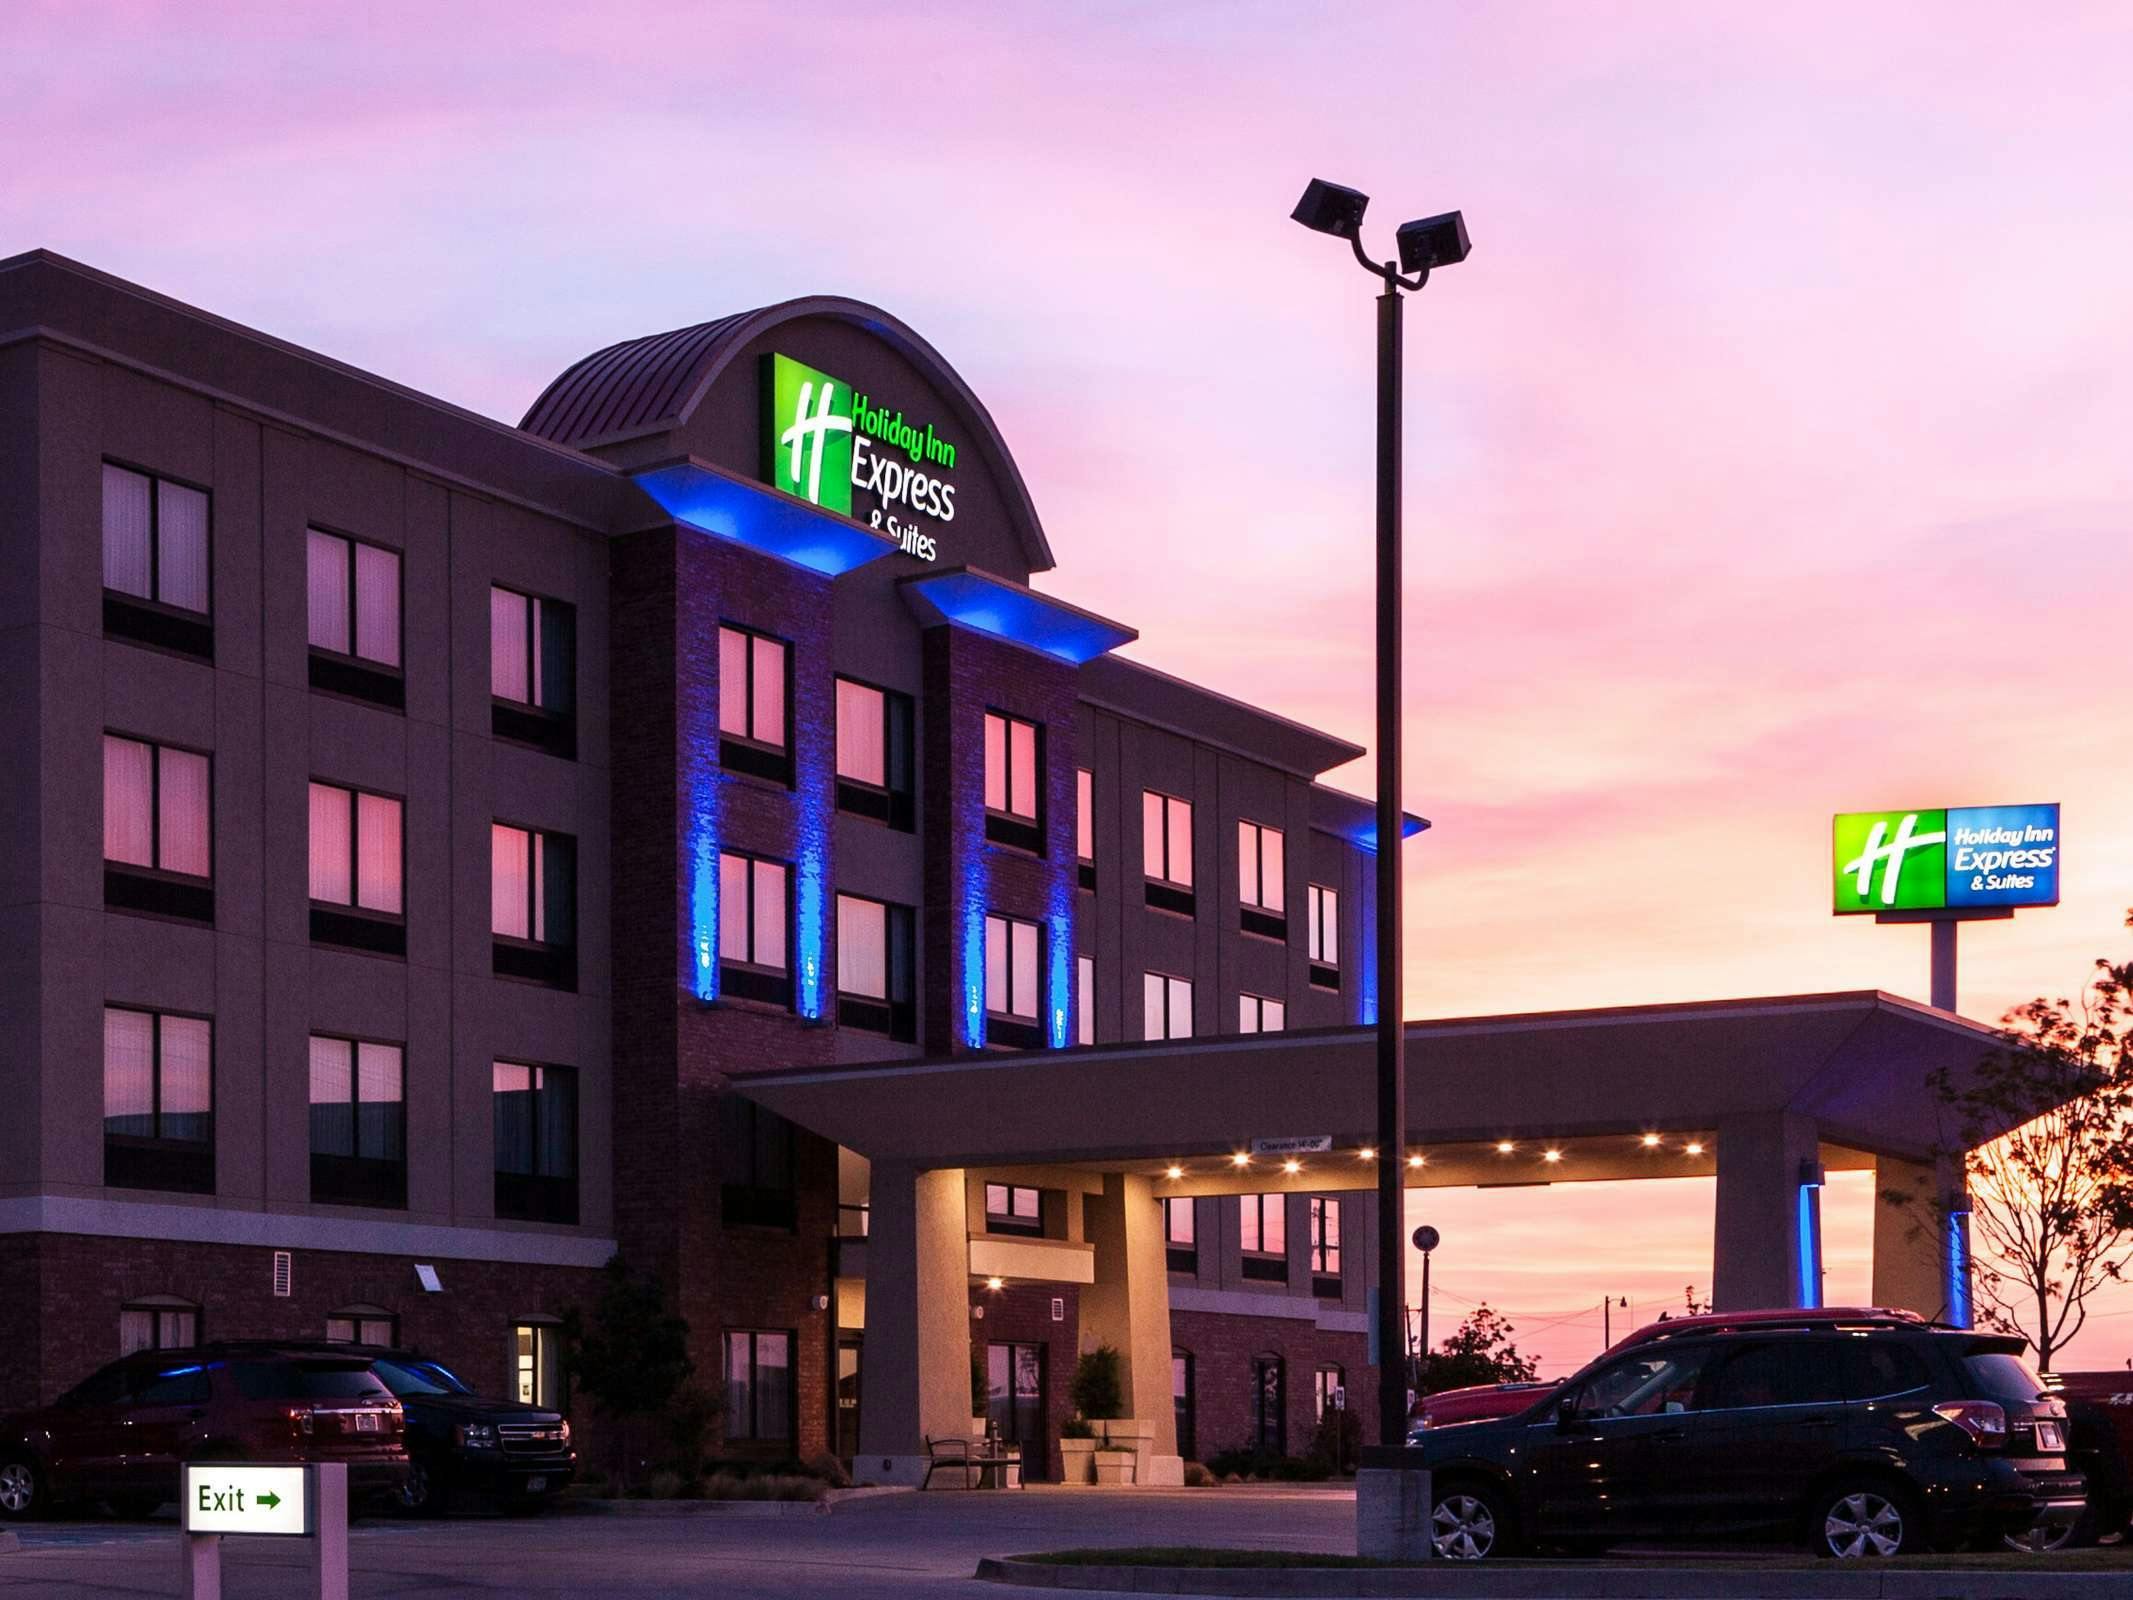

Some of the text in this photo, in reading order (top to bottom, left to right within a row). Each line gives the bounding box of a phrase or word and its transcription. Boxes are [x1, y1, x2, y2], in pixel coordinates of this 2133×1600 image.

[852, 392, 956, 469] Holiday Inn
[851, 435, 956, 522] Express
[886, 515, 937, 562] Suites
[1954, 824, 2054, 847] Holiday Inn
[1954, 847, 2054, 875] Express
[1971, 874, 2035, 891] & Suites
[199, 1484, 245, 1512] Exit
